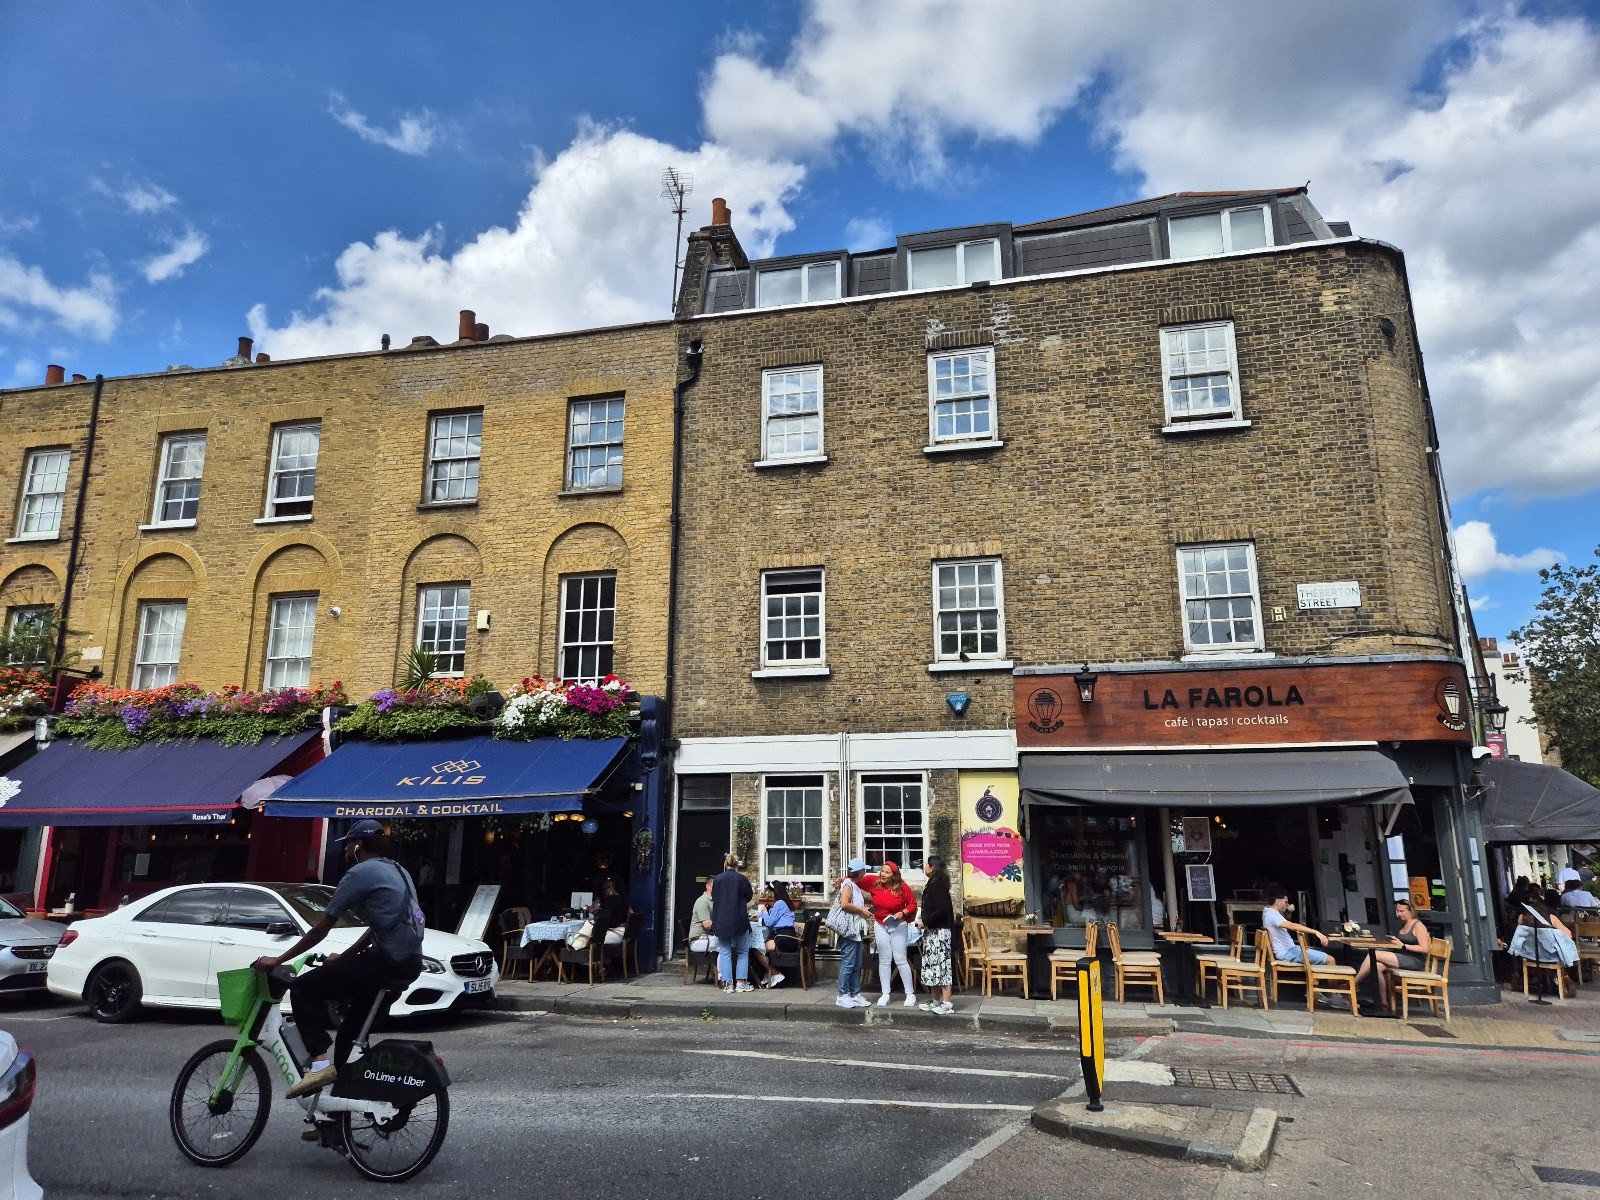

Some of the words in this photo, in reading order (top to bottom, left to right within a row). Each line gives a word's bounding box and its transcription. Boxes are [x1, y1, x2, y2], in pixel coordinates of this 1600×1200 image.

[1299, 587, 1359, 598] THEBERTON
[1300, 598, 1338, 607] STREET
[1143, 689, 1180, 710] LA
[1188, 684, 1305, 708] FAROLA
[1164, 716, 1189, 728] café
[1196, 717, 1229, 728] tapas
[1236, 713, 1289, 725] cocktails
[1443, 719, 1450, 728] LA
[1450, 721, 1466, 731] FAROL
[396, 775, 487, 787] KILIS
[336, 806, 413, 816] CHARCOAL
[417, 804, 428, 815] &
[431, 803, 504, 815] COCKTAIL
[1101, 851, 1129, 859] Cheese
[1054, 863, 1087, 871] Cocktails
[1089, 863, 1095, 871] &
[1098, 864, 1125, 872] Sangria
[272, 1040, 295, 1086] Lime
[364, 1070, 376, 1080] On
[376, 1071, 396, 1083] Lime
[403, 1076, 426, 1087] Uber
